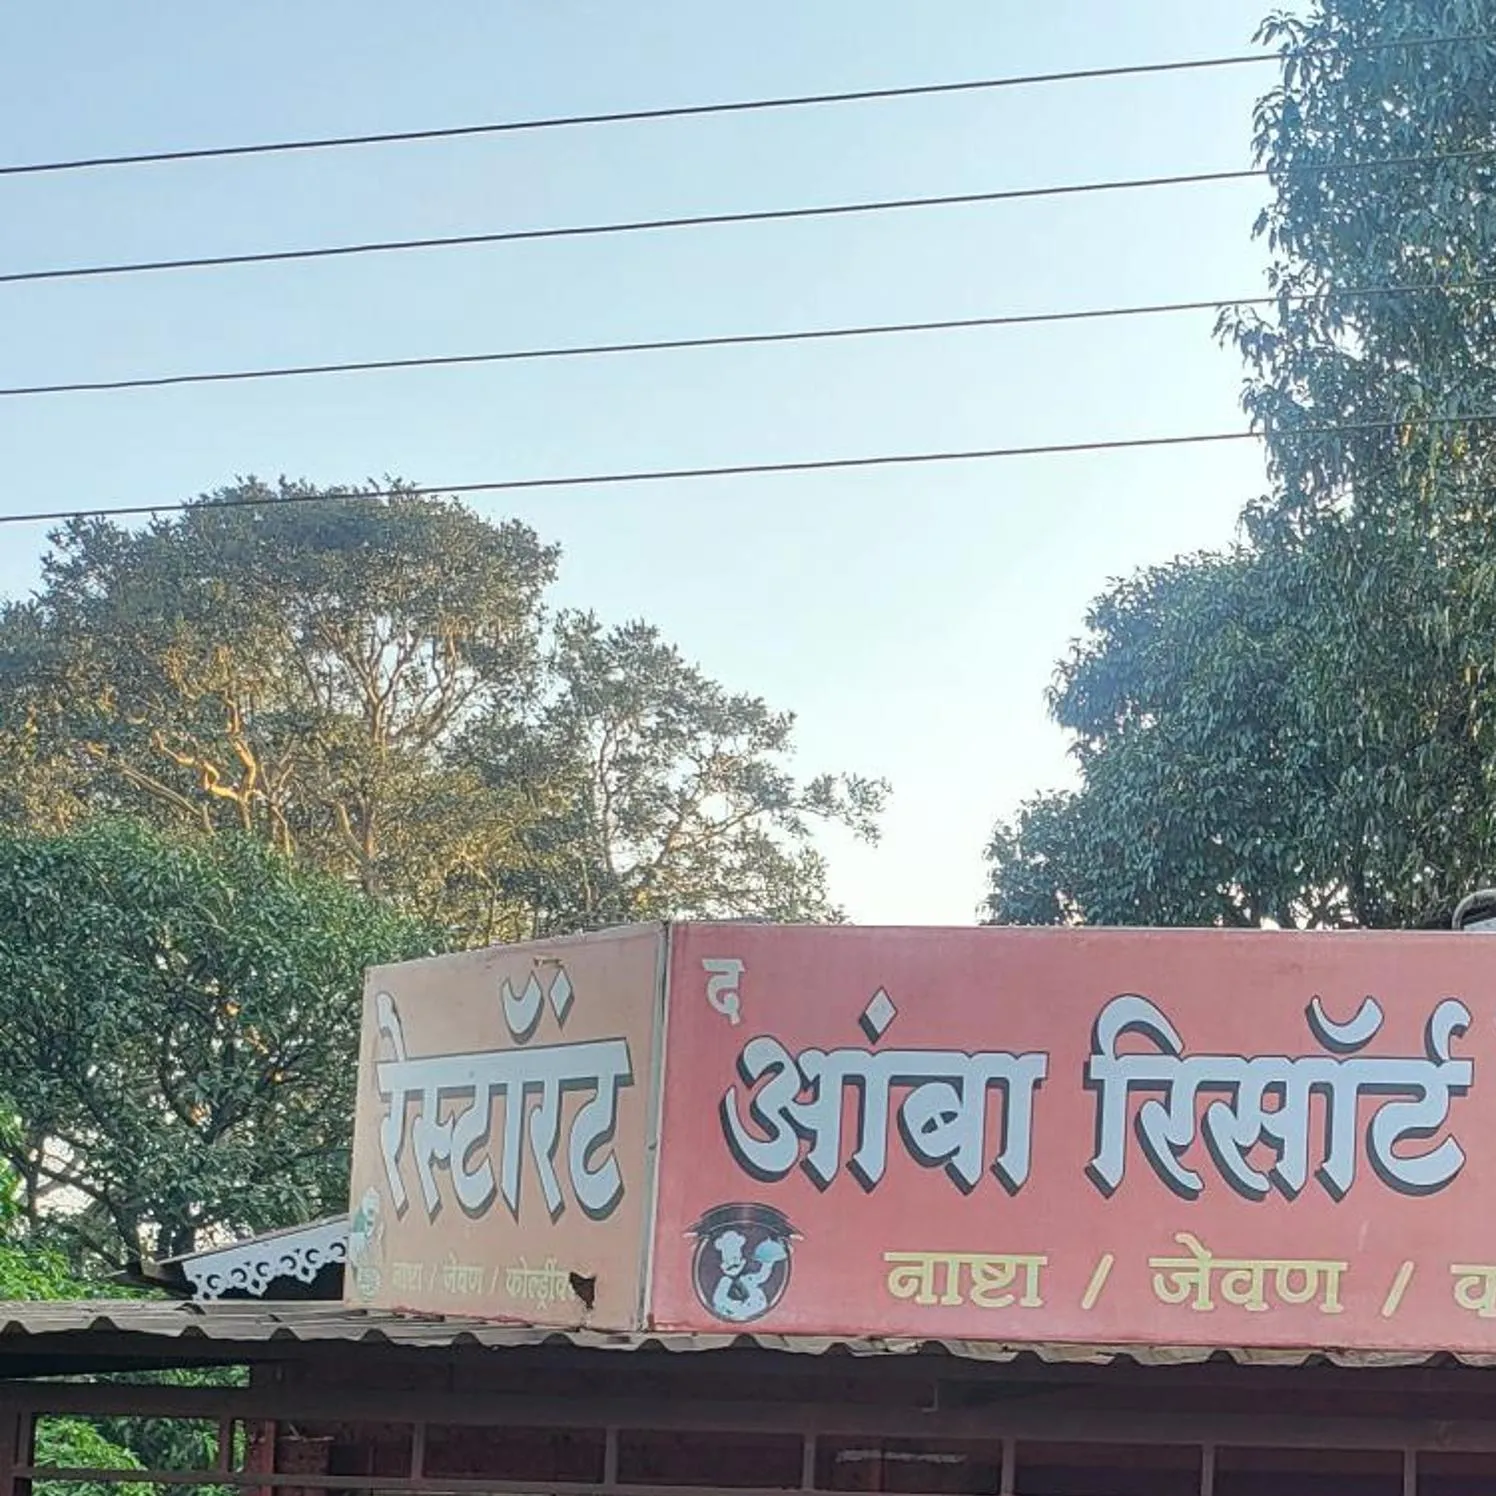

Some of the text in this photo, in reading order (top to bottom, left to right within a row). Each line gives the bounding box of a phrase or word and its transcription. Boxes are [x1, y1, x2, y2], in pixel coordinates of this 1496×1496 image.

[701, 958, 746, 1025] द
[375, 969, 635, 1225] रेस्टॉरंट
[719, 986, 1049, 1197] आंबा
[1083, 994, 1475, 1202] रिसॉर्ट
[884, 1252, 1048, 1307] नाष्टा
[1148, 1232, 1348, 1314] जेवण
